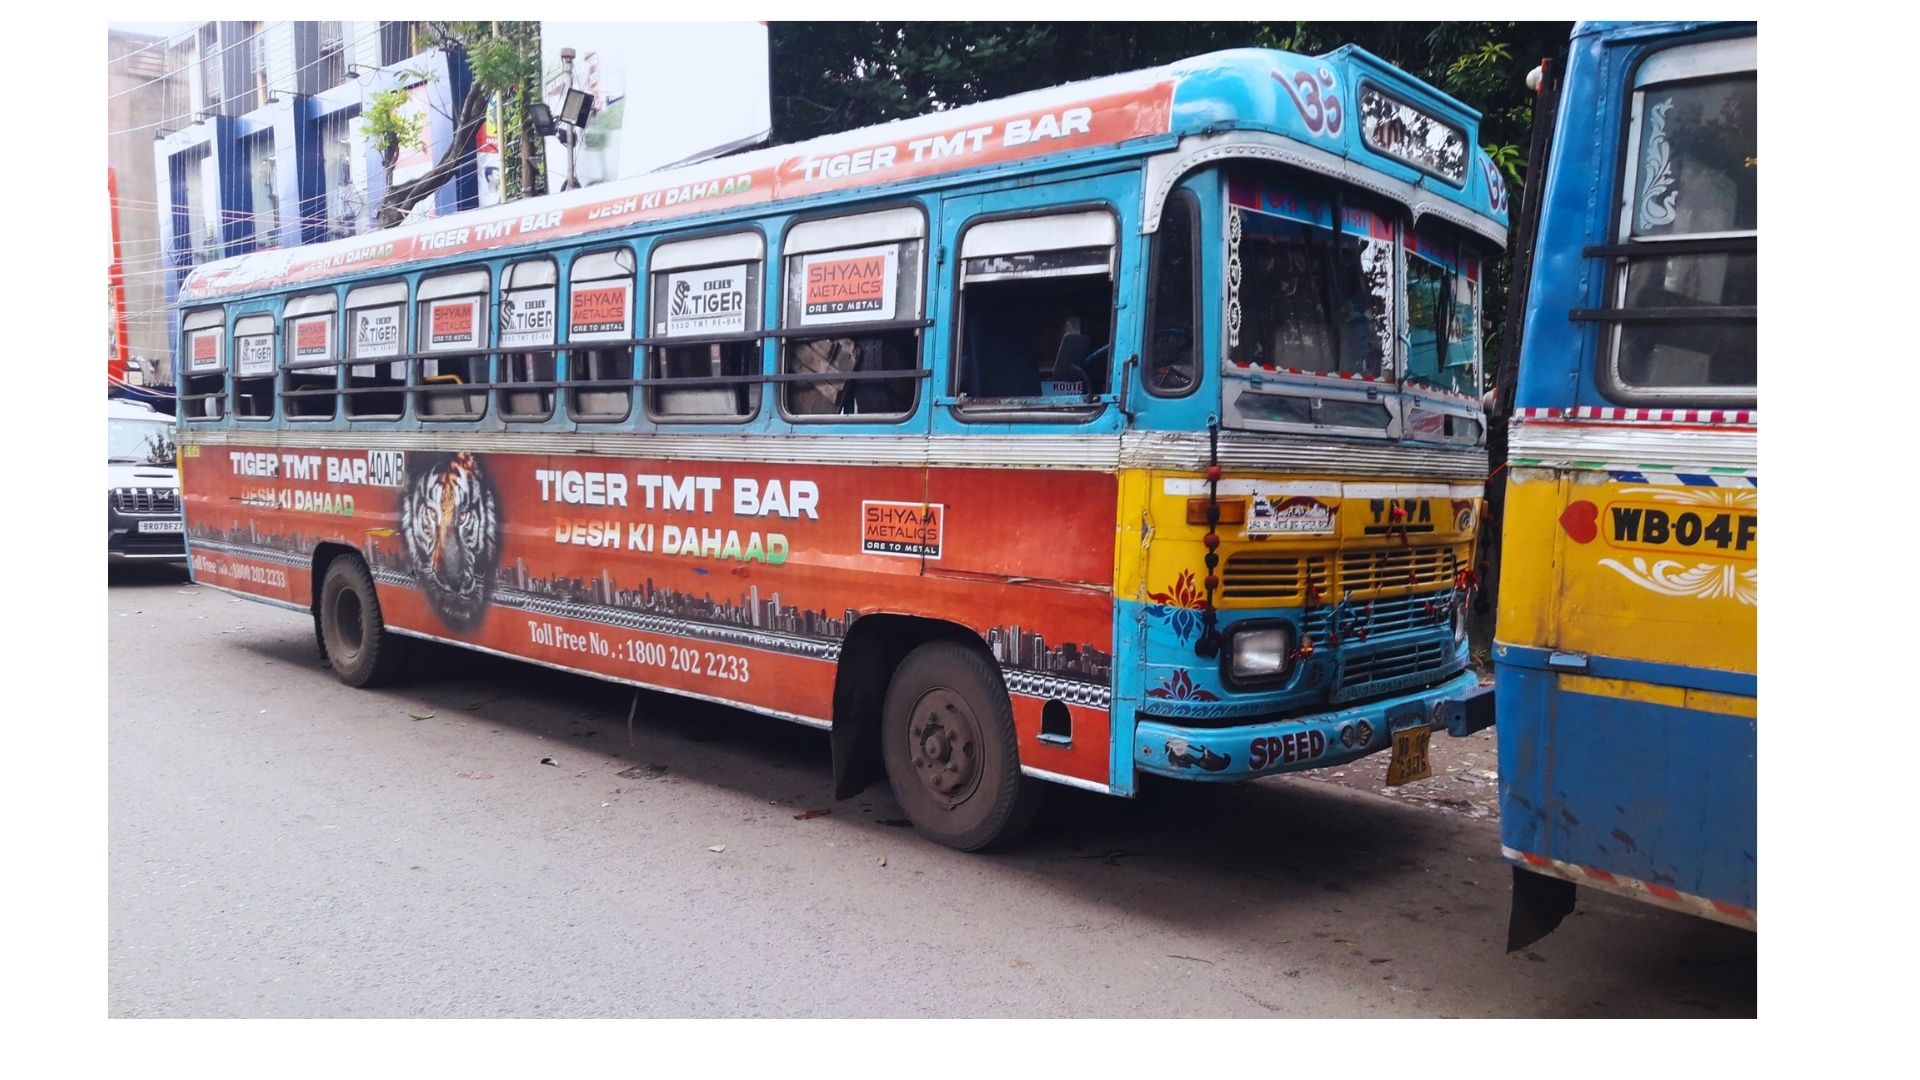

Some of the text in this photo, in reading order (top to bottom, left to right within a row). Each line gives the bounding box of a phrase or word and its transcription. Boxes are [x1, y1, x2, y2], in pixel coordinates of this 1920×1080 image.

[800, 107, 1093, 182] TIGER TMT BAR
[641, 191, 662, 211] KI
[665, 174, 752, 206] DAHAAD
[420, 210, 564, 250] TIGER TMT BAR
[345, 243, 394, 264] DAHAAD
[810, 261, 880, 283] SHYAM
[809, 280, 881, 298] METALICS
[574, 291, 624, 308] SHYAM
[692, 290, 743, 315] TIGER
[808, 300, 880, 313] ORE TO METAL
[434, 307, 472, 321] SHYAM
[516, 310, 553, 329] TIGER
[573, 306, 624, 320] METALICS
[694, 320, 710, 328] TMT
[712, 317, 743, 327] RE-BAR
[369, 325, 398, 341] TIGER
[573, 324, 588, 333] ORE
[600, 322, 624, 331] METAL
[250, 347, 272, 360] TIGER
[1053, 383, 1083, 392] ROUTE
[229, 452, 368, 485] TIGER TMT BAR
[369, 451, 405, 487] 40A/B
[241, 485, 355, 517] DESH KI DAHAAD
[535, 469, 820, 519] TIGER TMT BAR
[867, 508, 937, 526] SHYAM
[555, 516, 790, 565] DESH KI DAHAAD
[866, 525, 937, 540] METALICS
[866, 542, 937, 554] ORE TO METAL
[250, 565, 265, 585] 202
[265, 567, 286, 588] 2233
[528, 620, 553, 647] Toll
[555, 625, 587, 652] Free
[626, 638, 667, 668] 1800
[669, 646, 701, 675] 202
[704, 651, 750, 683] 2233
[1248, 729, 1326, 771] SPEED
